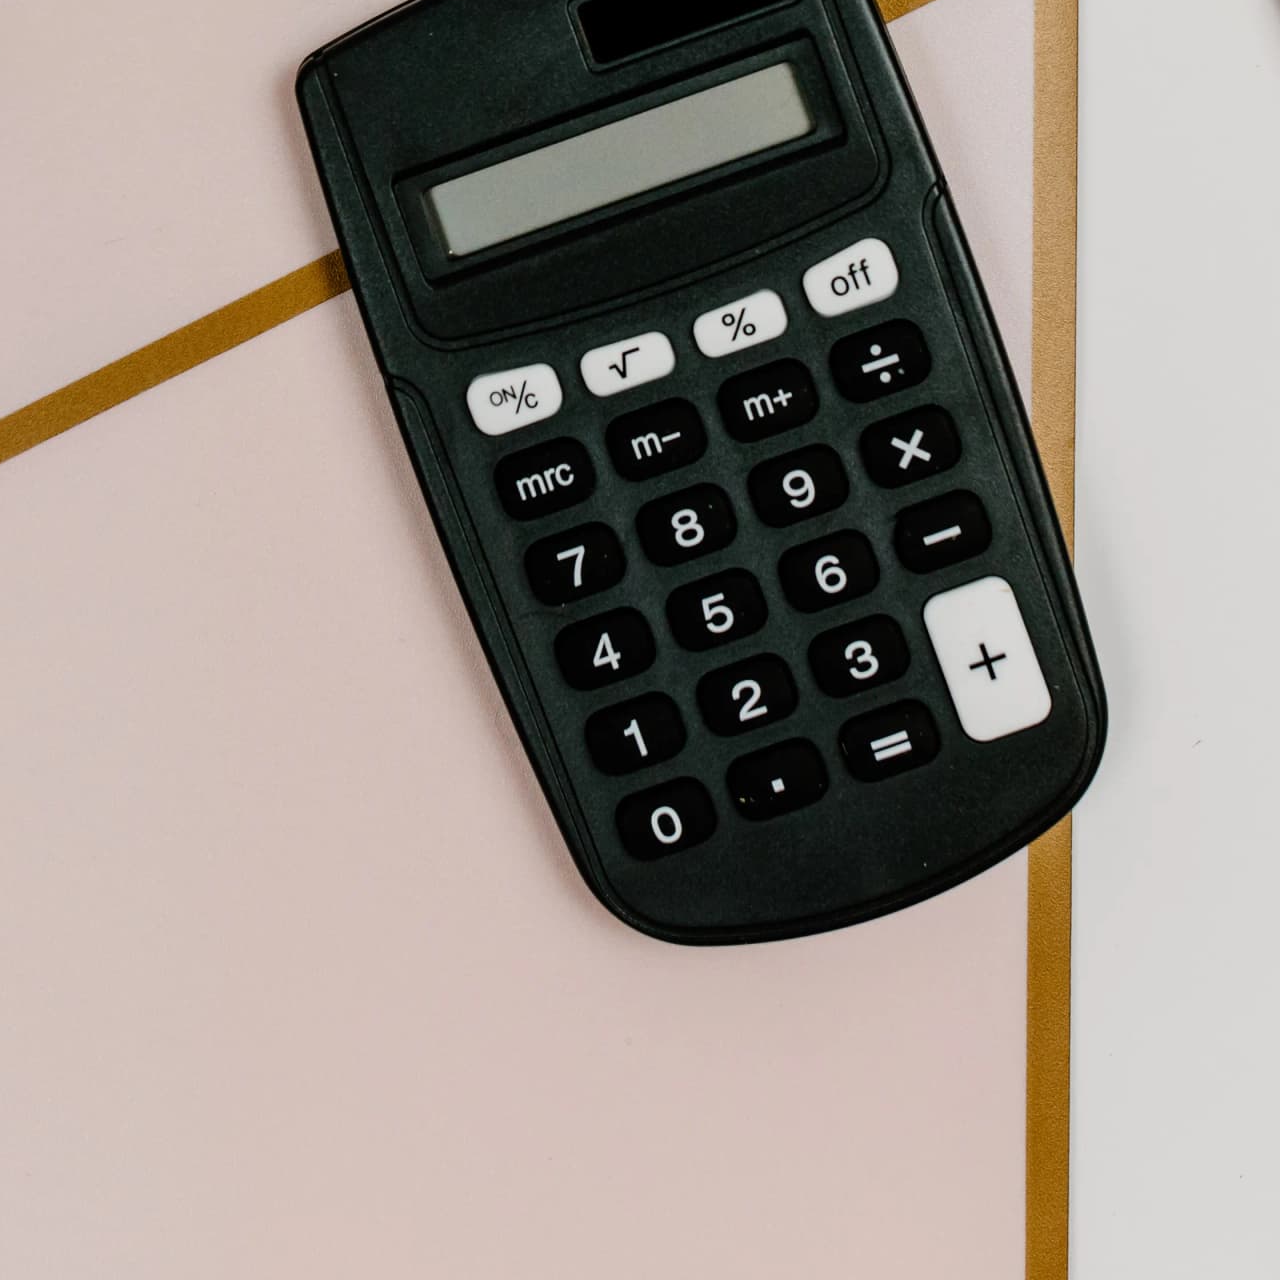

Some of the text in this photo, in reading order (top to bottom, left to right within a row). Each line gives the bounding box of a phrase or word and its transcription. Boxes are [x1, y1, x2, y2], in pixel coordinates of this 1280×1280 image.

[721, 307, 757, 342] %
[830, 258, 872, 297] off
[517, 464, 573, 500] mrc
[744, 390, 792, 420] m+
[557, 546, 584, 586] 7
[672, 510, 704, 546] 8
[783, 470, 814, 507] 9
[594, 633, 620, 669] 4
[703, 594, 733, 632] 5
[816, 556, 846, 593] 6
[624, 720, 647, 755] 1
[732, 680, 767, 721] 2
[845, 641, 878, 678] 3
